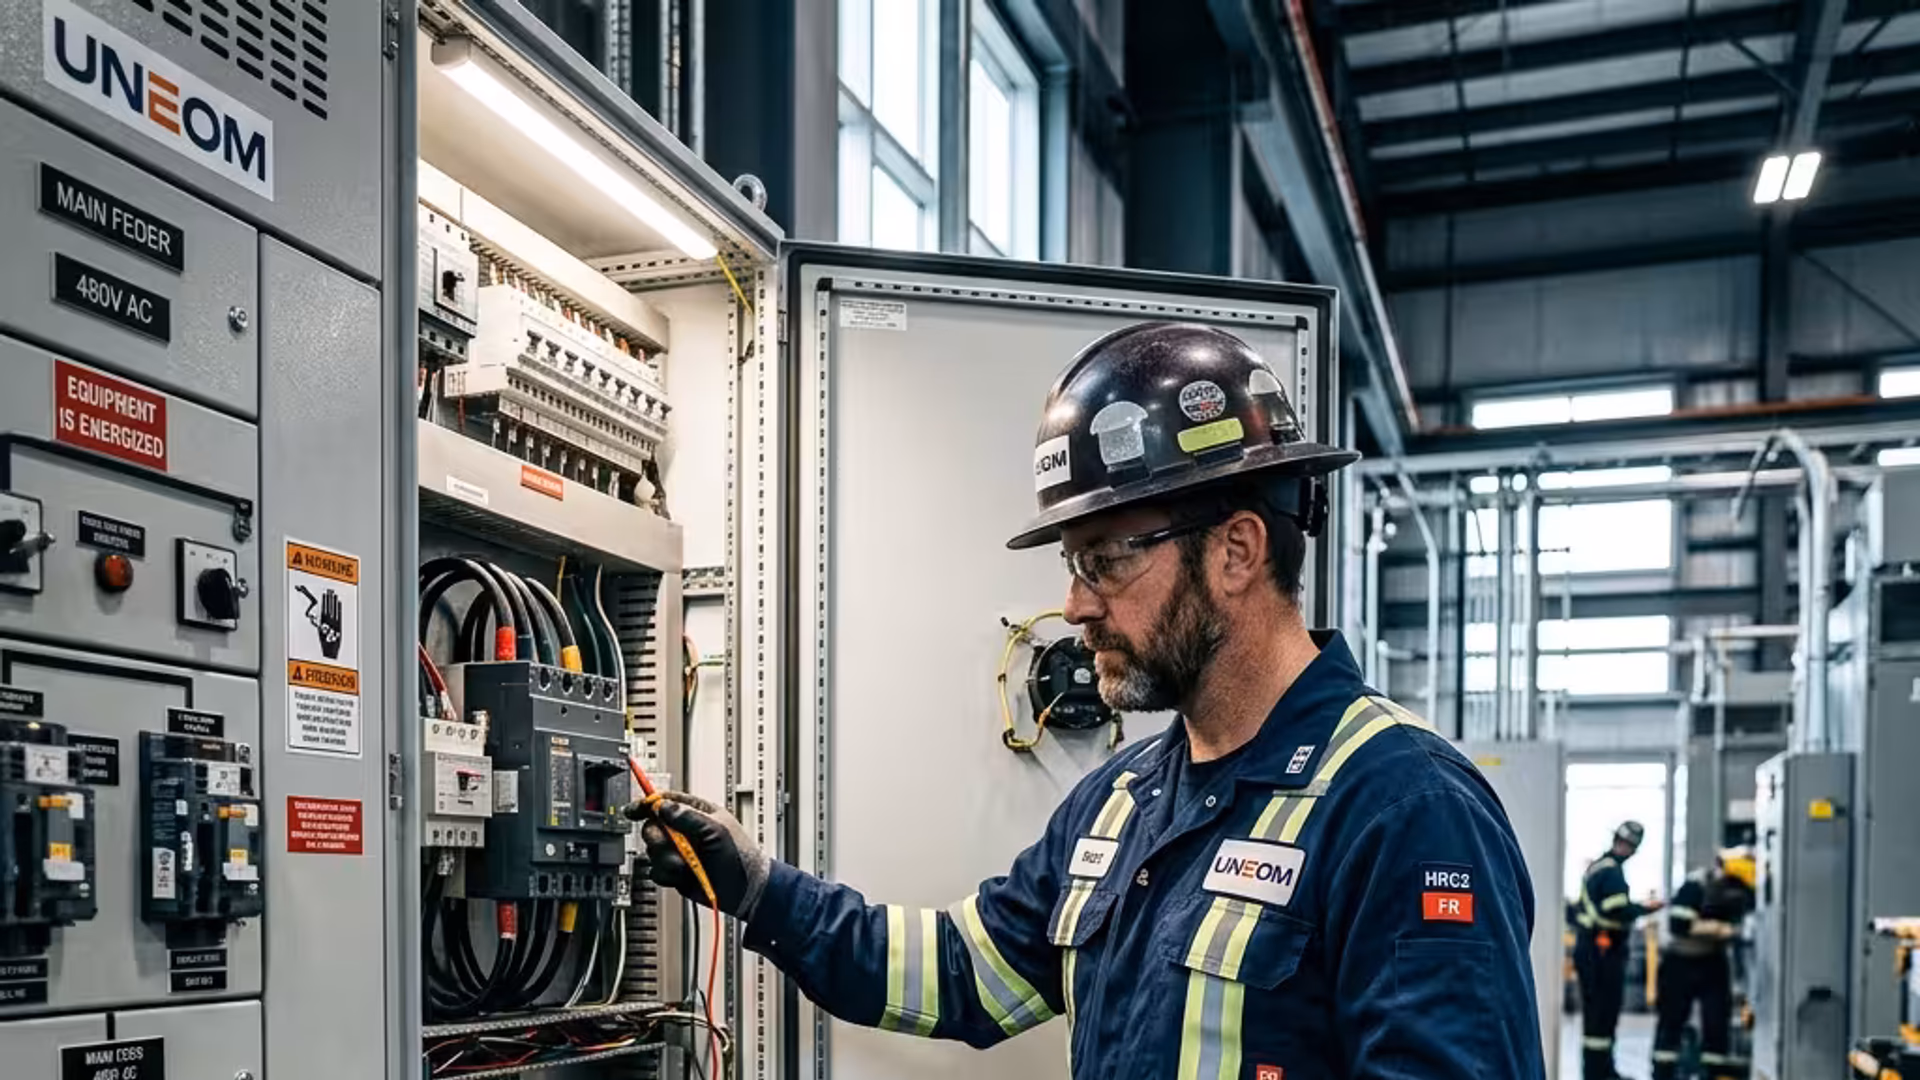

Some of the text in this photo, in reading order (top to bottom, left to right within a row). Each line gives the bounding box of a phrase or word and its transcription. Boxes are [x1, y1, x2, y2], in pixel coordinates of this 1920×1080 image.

[54, 17, 267, 182] UNEOM
[57, 181, 172, 255] MAIN FEDER
[76, 274, 153, 324] 480V AC
[60, 407, 164, 459] IS ENERGIZED
[1214, 856, 1293, 886] UNEOM
[1425, 871, 1470, 888] HRC2
[1438, 898, 1460, 915] FR
